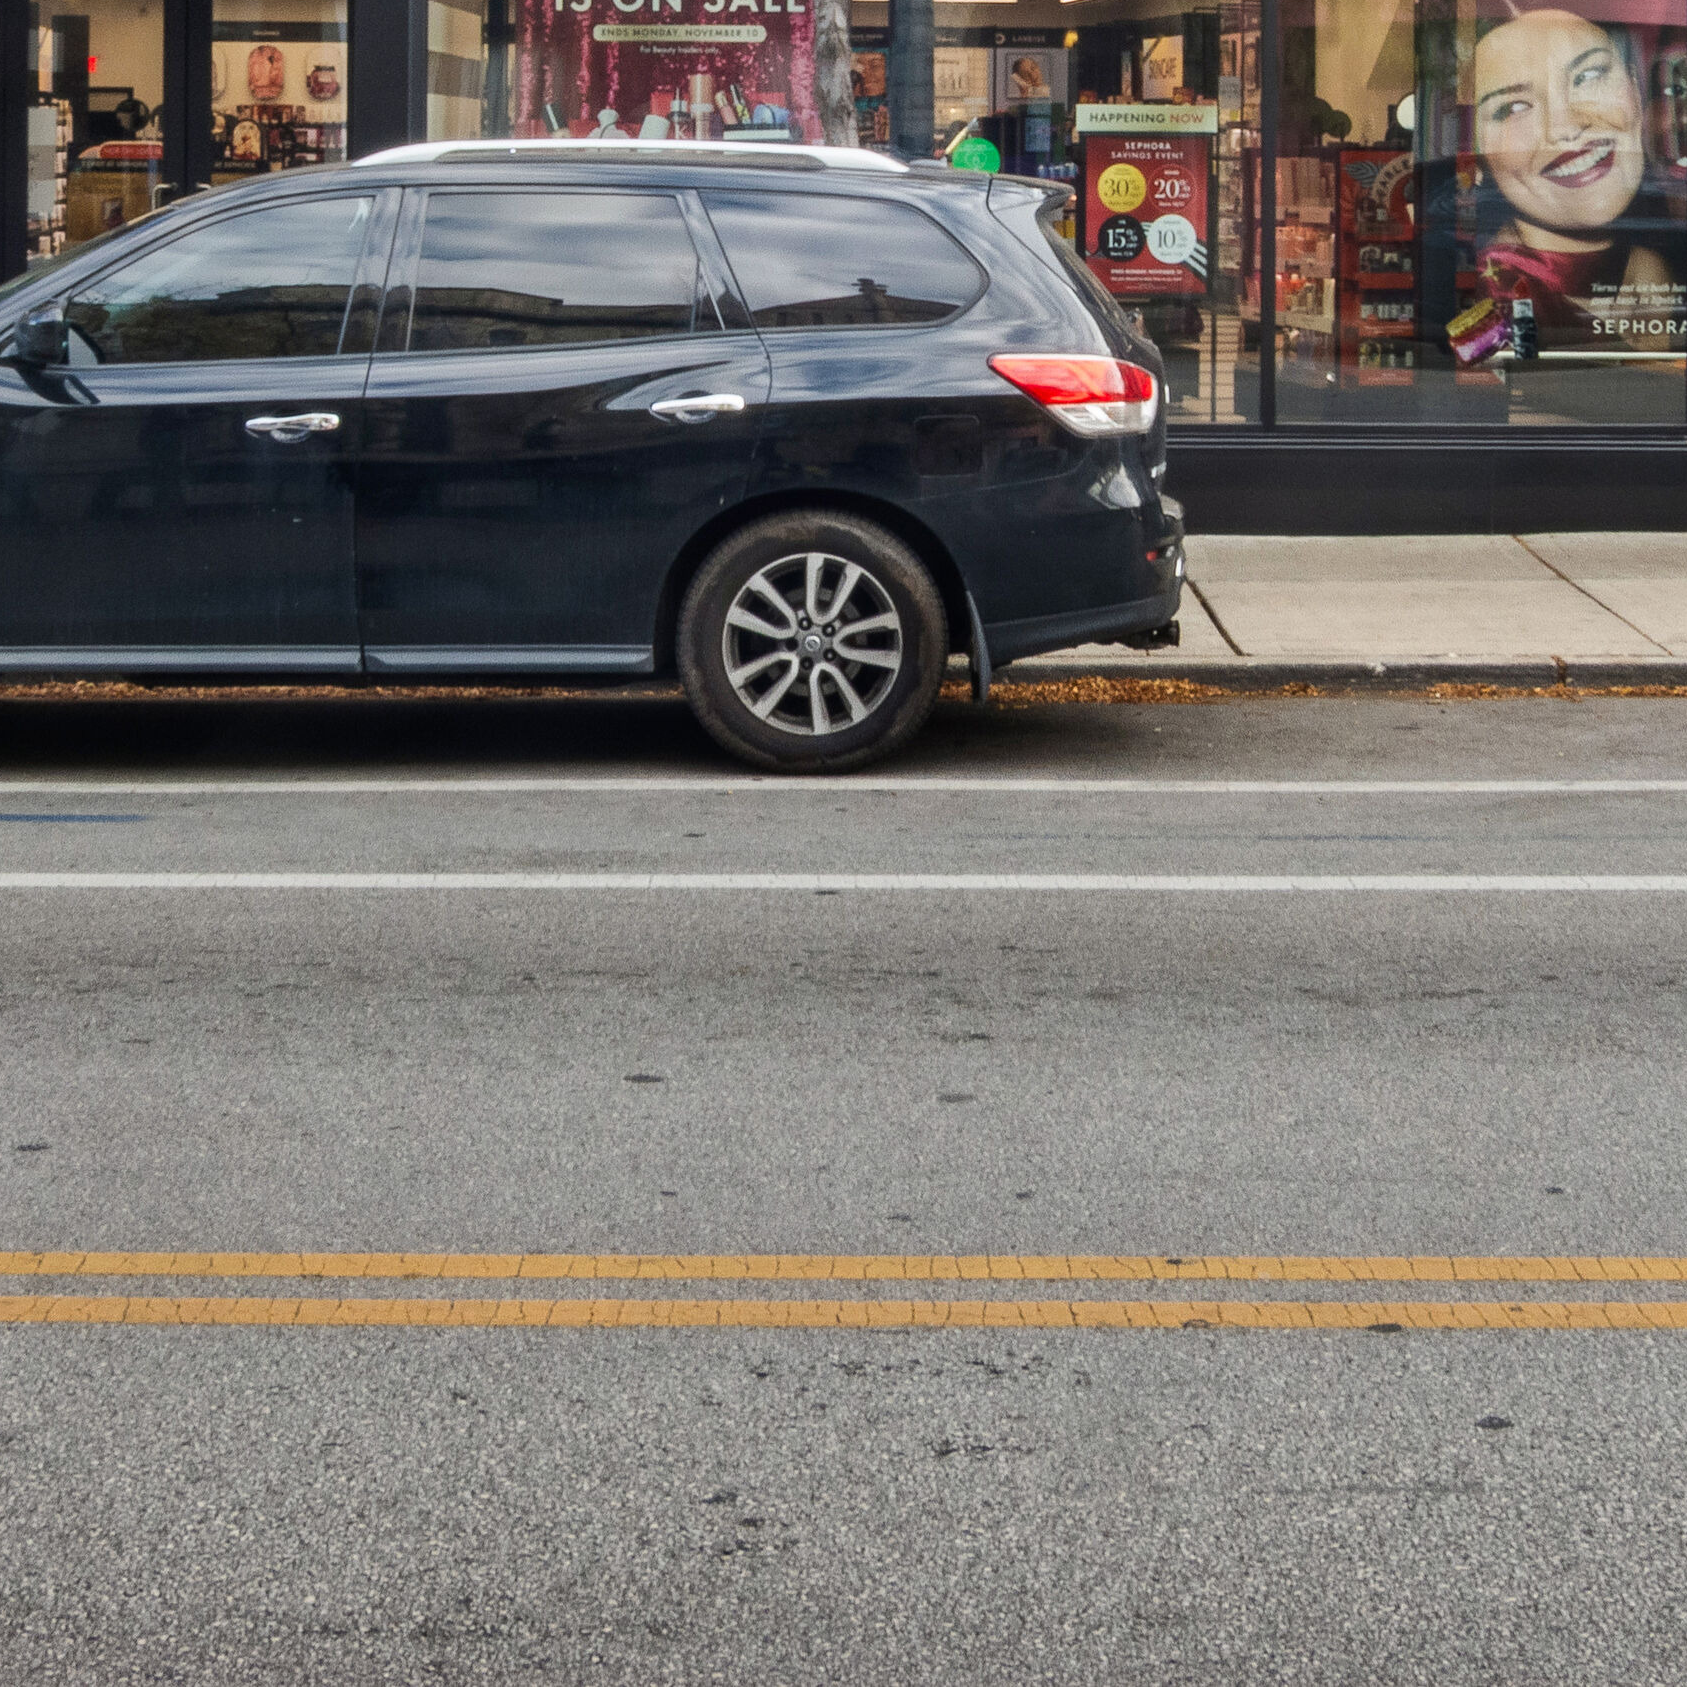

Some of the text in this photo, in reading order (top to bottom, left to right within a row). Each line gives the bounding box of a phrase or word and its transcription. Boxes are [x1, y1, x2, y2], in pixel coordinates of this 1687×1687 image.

[601, 28, 629, 37] ENDS
[685, 28, 742, 38] NOVEMBER
[1089, 113, 1204, 123] HAPPENING NOW
[1125, 142, 1172, 150] SEPHORA
[1111, 151, 1184, 160] SAVINGS EVENT
[1592, 319, 1687, 334] SEPHORA
